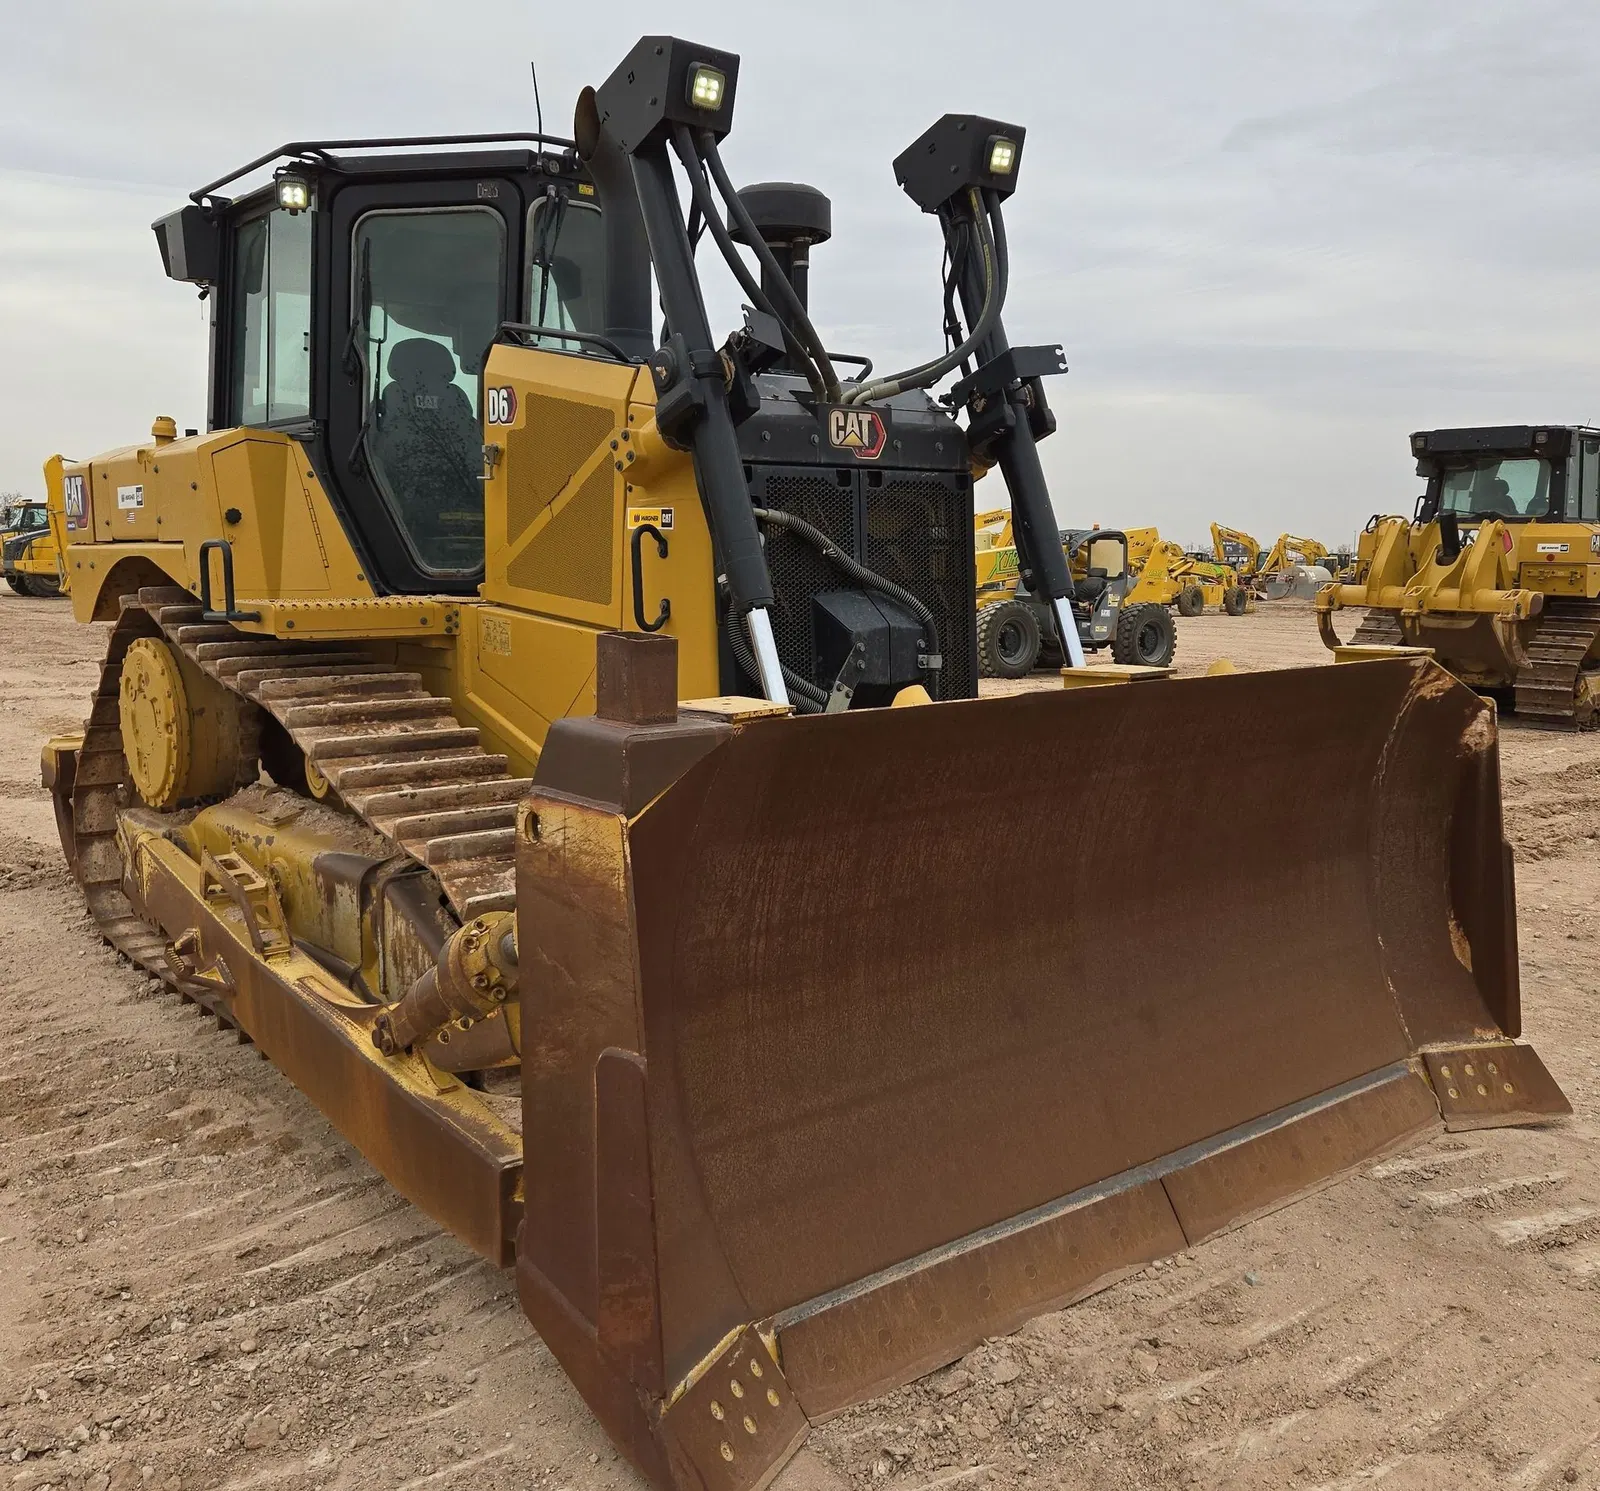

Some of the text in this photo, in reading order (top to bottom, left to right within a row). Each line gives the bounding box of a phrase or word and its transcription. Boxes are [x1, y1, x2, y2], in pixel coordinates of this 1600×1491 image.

[415, 395, 438, 409] CAT
[488, 388, 509, 422] D6
[830, 410, 872, 447] CAT
[64, 476, 83, 516] CAT
[662, 513, 672, 523] CAT
